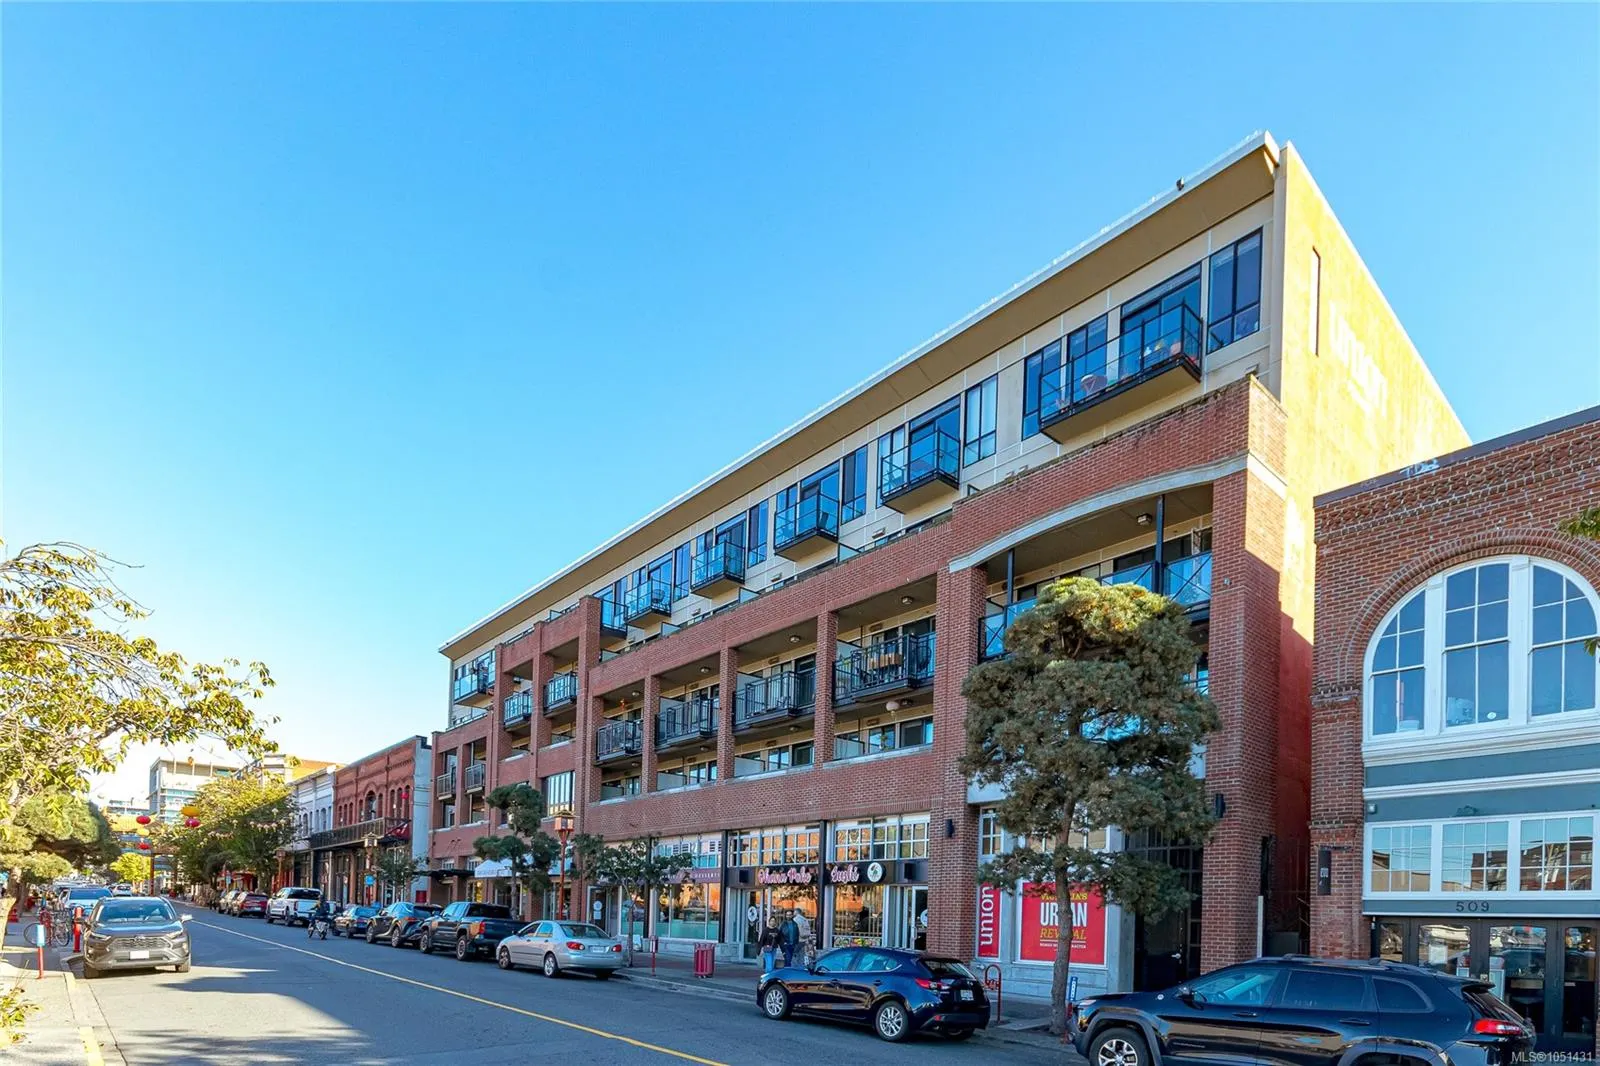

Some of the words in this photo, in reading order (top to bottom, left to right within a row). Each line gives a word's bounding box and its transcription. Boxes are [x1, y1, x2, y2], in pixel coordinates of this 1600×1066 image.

[1040, 902, 1088, 927] URAN
[1456, 901, 1489, 912] 509
[980, 886, 994, 946] union
[1040, 928, 1087, 940] REVAL
